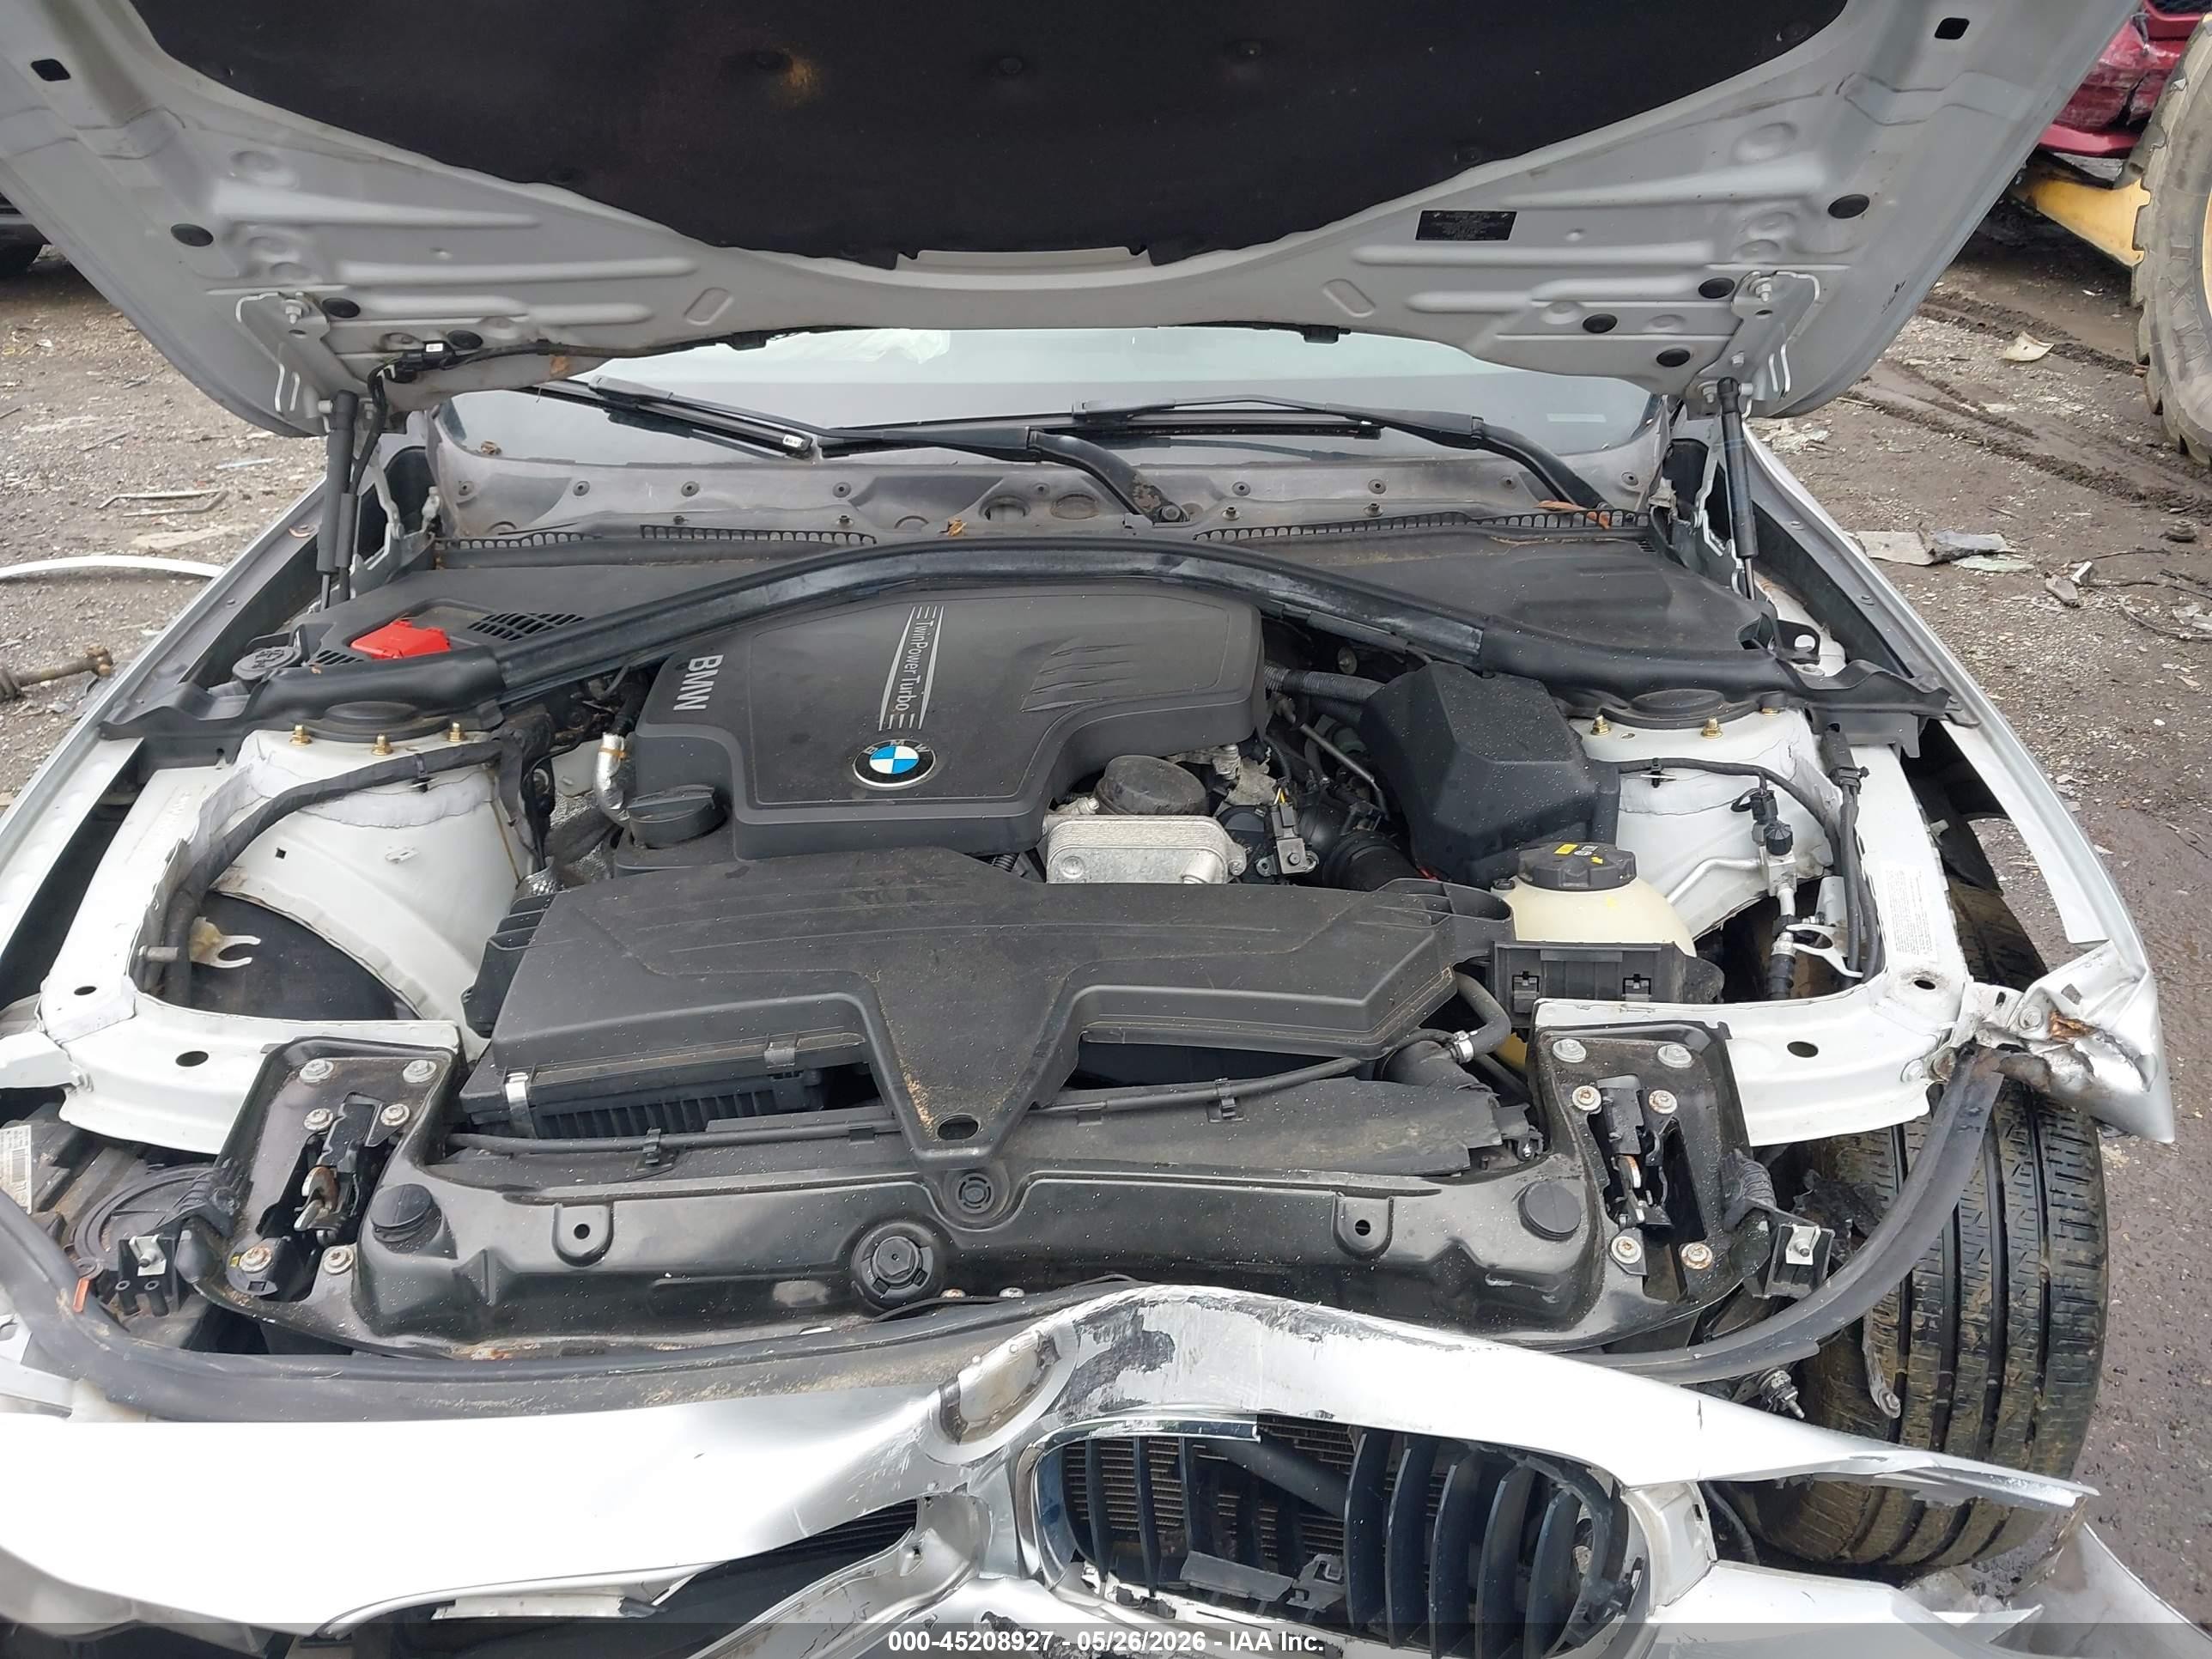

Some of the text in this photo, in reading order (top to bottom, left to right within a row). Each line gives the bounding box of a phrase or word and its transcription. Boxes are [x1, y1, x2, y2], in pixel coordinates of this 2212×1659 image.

[673, 654, 724, 710] BMW
[895, 620, 934, 711] TwinPower Turbo
